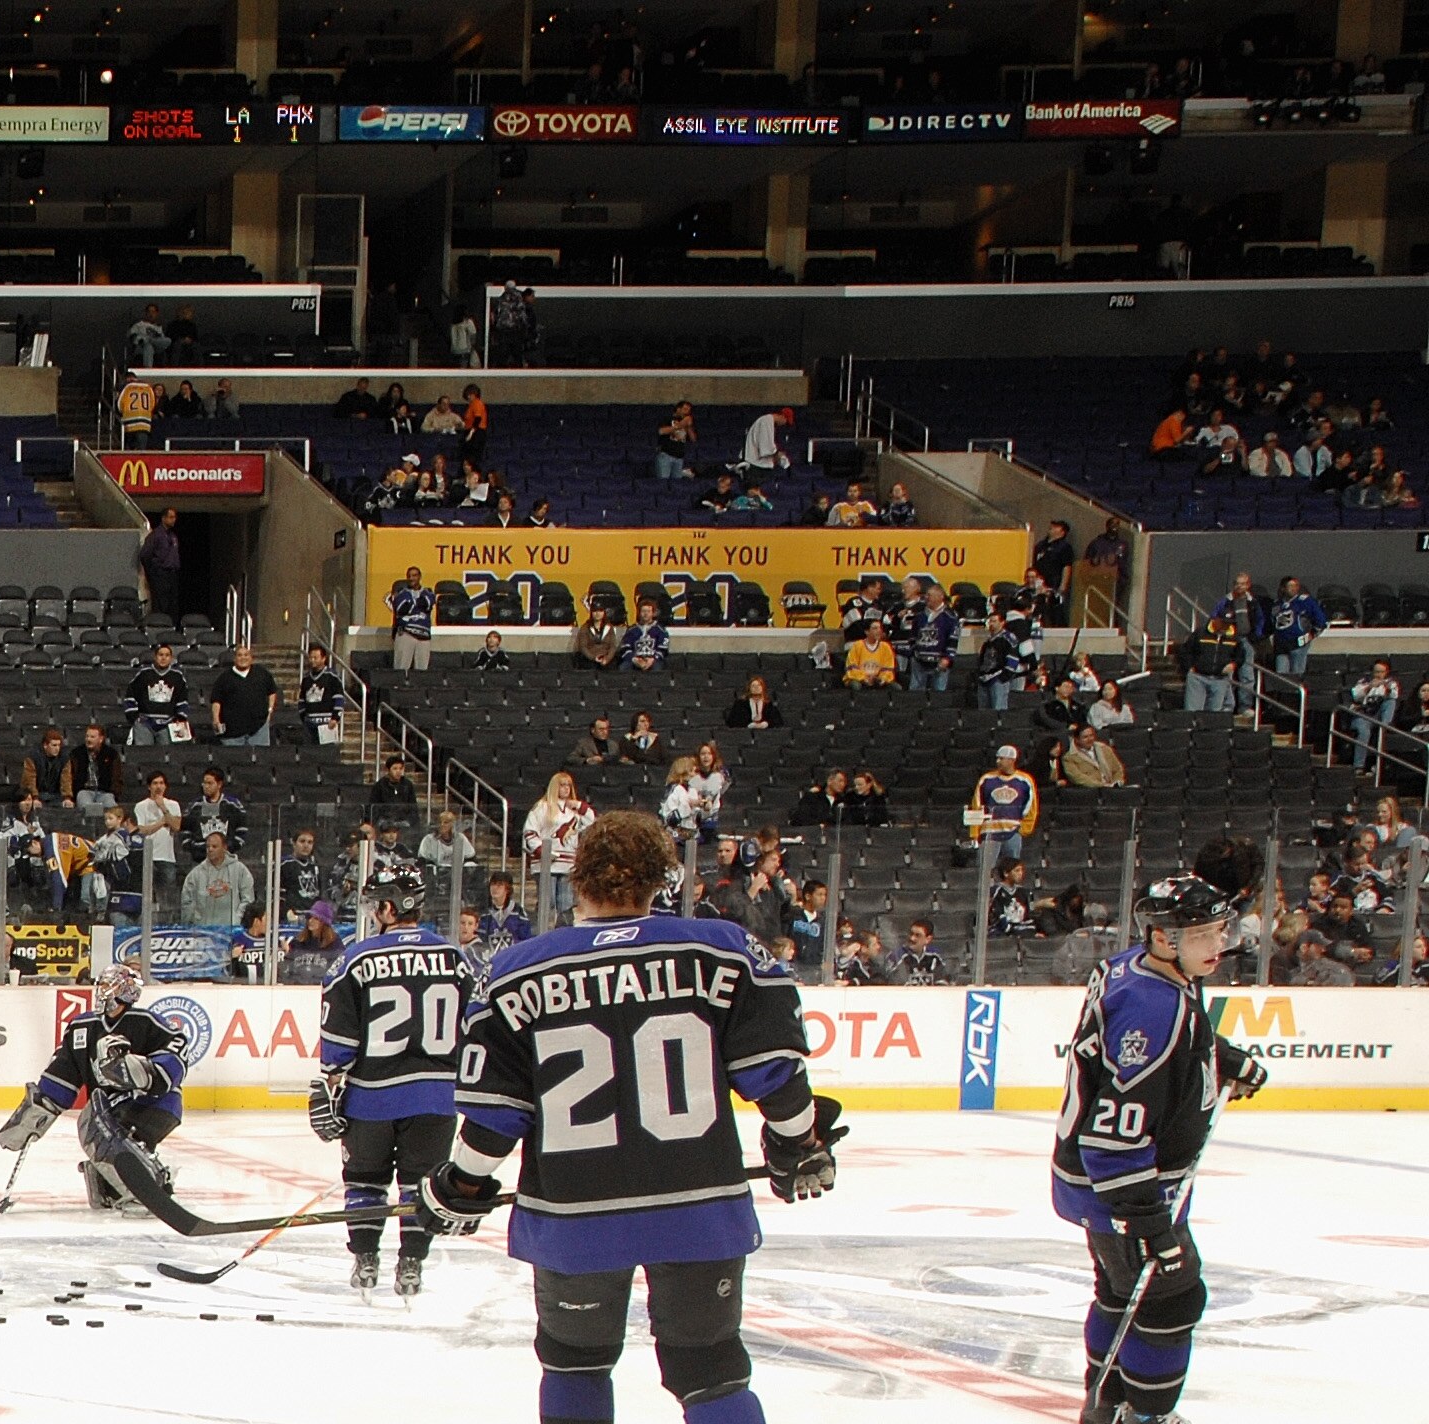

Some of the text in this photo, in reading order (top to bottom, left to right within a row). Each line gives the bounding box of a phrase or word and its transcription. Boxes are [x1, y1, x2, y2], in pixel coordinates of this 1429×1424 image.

[131, 109, 195, 124] SHOTS
[225, 104, 314, 125] LA PHX
[899, 113, 1012, 131] DIRECTV
[1025, 103, 1142, 120] Bank of America
[40, 116, 103, 136] Energy
[123, 124, 202, 139] ON GOAL
[382, 112, 469, 133] PEPSI
[533, 112, 632, 133] TOYOTA
[662, 116, 840, 136] ASSIL EYE INSTITUTE
[233, 124, 298, 143] 1 1
[291, 297, 317, 311] PR15
[1109, 294, 1135, 309] PR16
[129, 391, 149, 412] 20
[153, 467, 243, 482] McDonald's
[435, 544, 571, 566] THANK YOU
[633, 544, 769, 566] THANK YOU
[831, 546, 966, 568] THANK YOU
[351, 949, 469, 988] ROBITAIL
[495, 957, 741, 1032] ROBITAILLE
[367, 983, 460, 1057] 20
[214, 1009, 321, 1059] AA
[801, 1009, 923, 1060] OTA
[1245, 1042, 1393, 1060] AGEMENT
[533, 1011, 719, 1153] 20
[1092, 1099, 1145, 1138] 20
